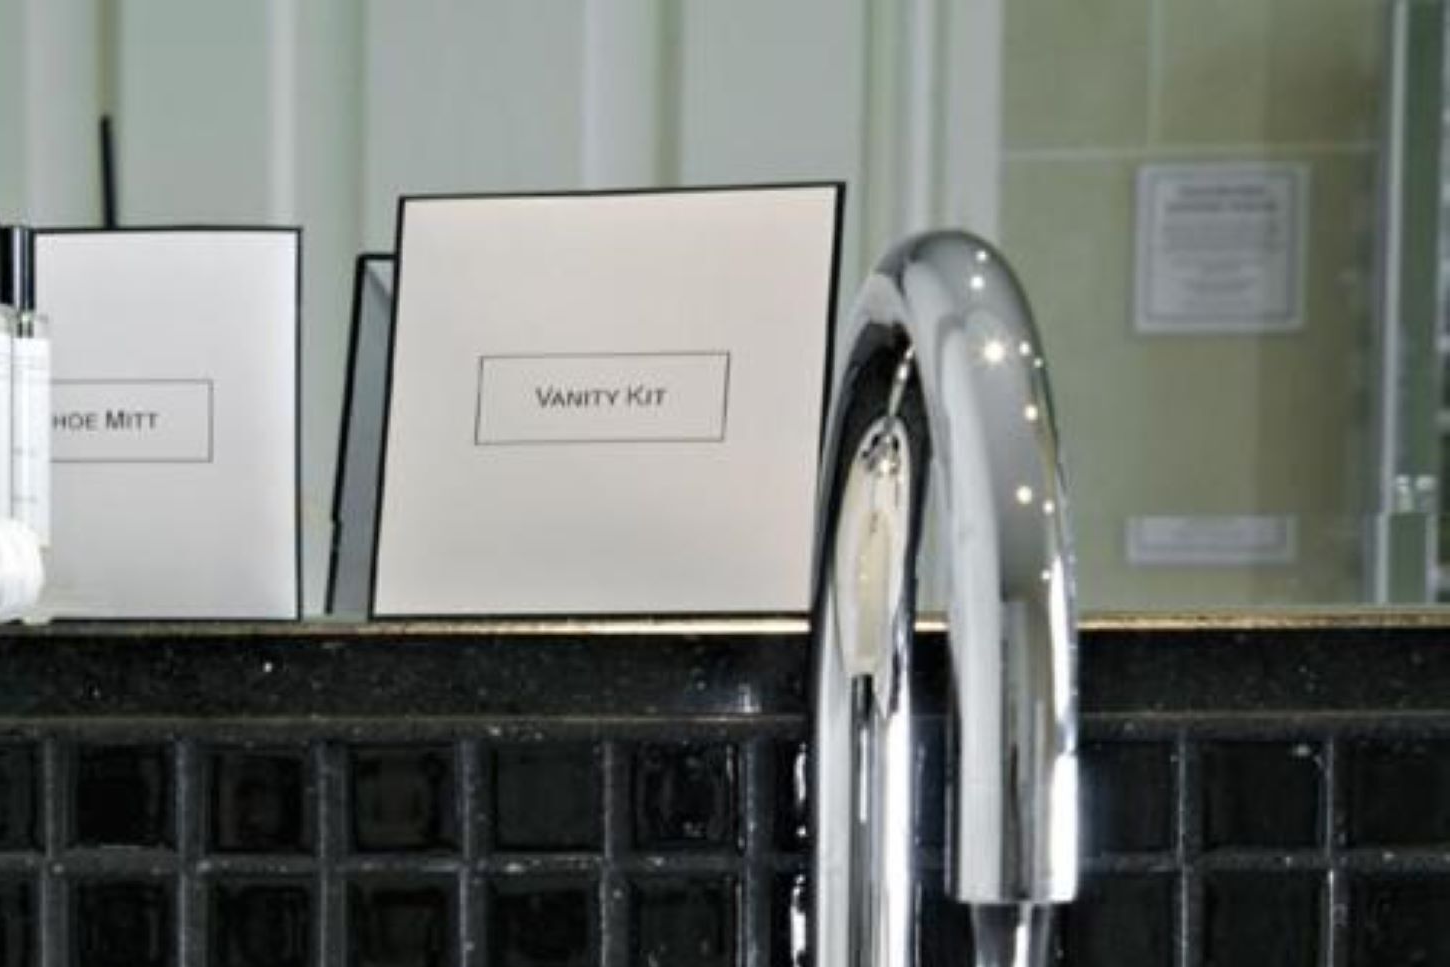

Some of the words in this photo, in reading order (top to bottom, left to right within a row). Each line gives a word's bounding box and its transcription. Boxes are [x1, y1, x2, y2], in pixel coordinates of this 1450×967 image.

[535, 384, 621, 408] VANITY
[628, 384, 667, 407] KIT
[105, 409, 159, 430] MITT
